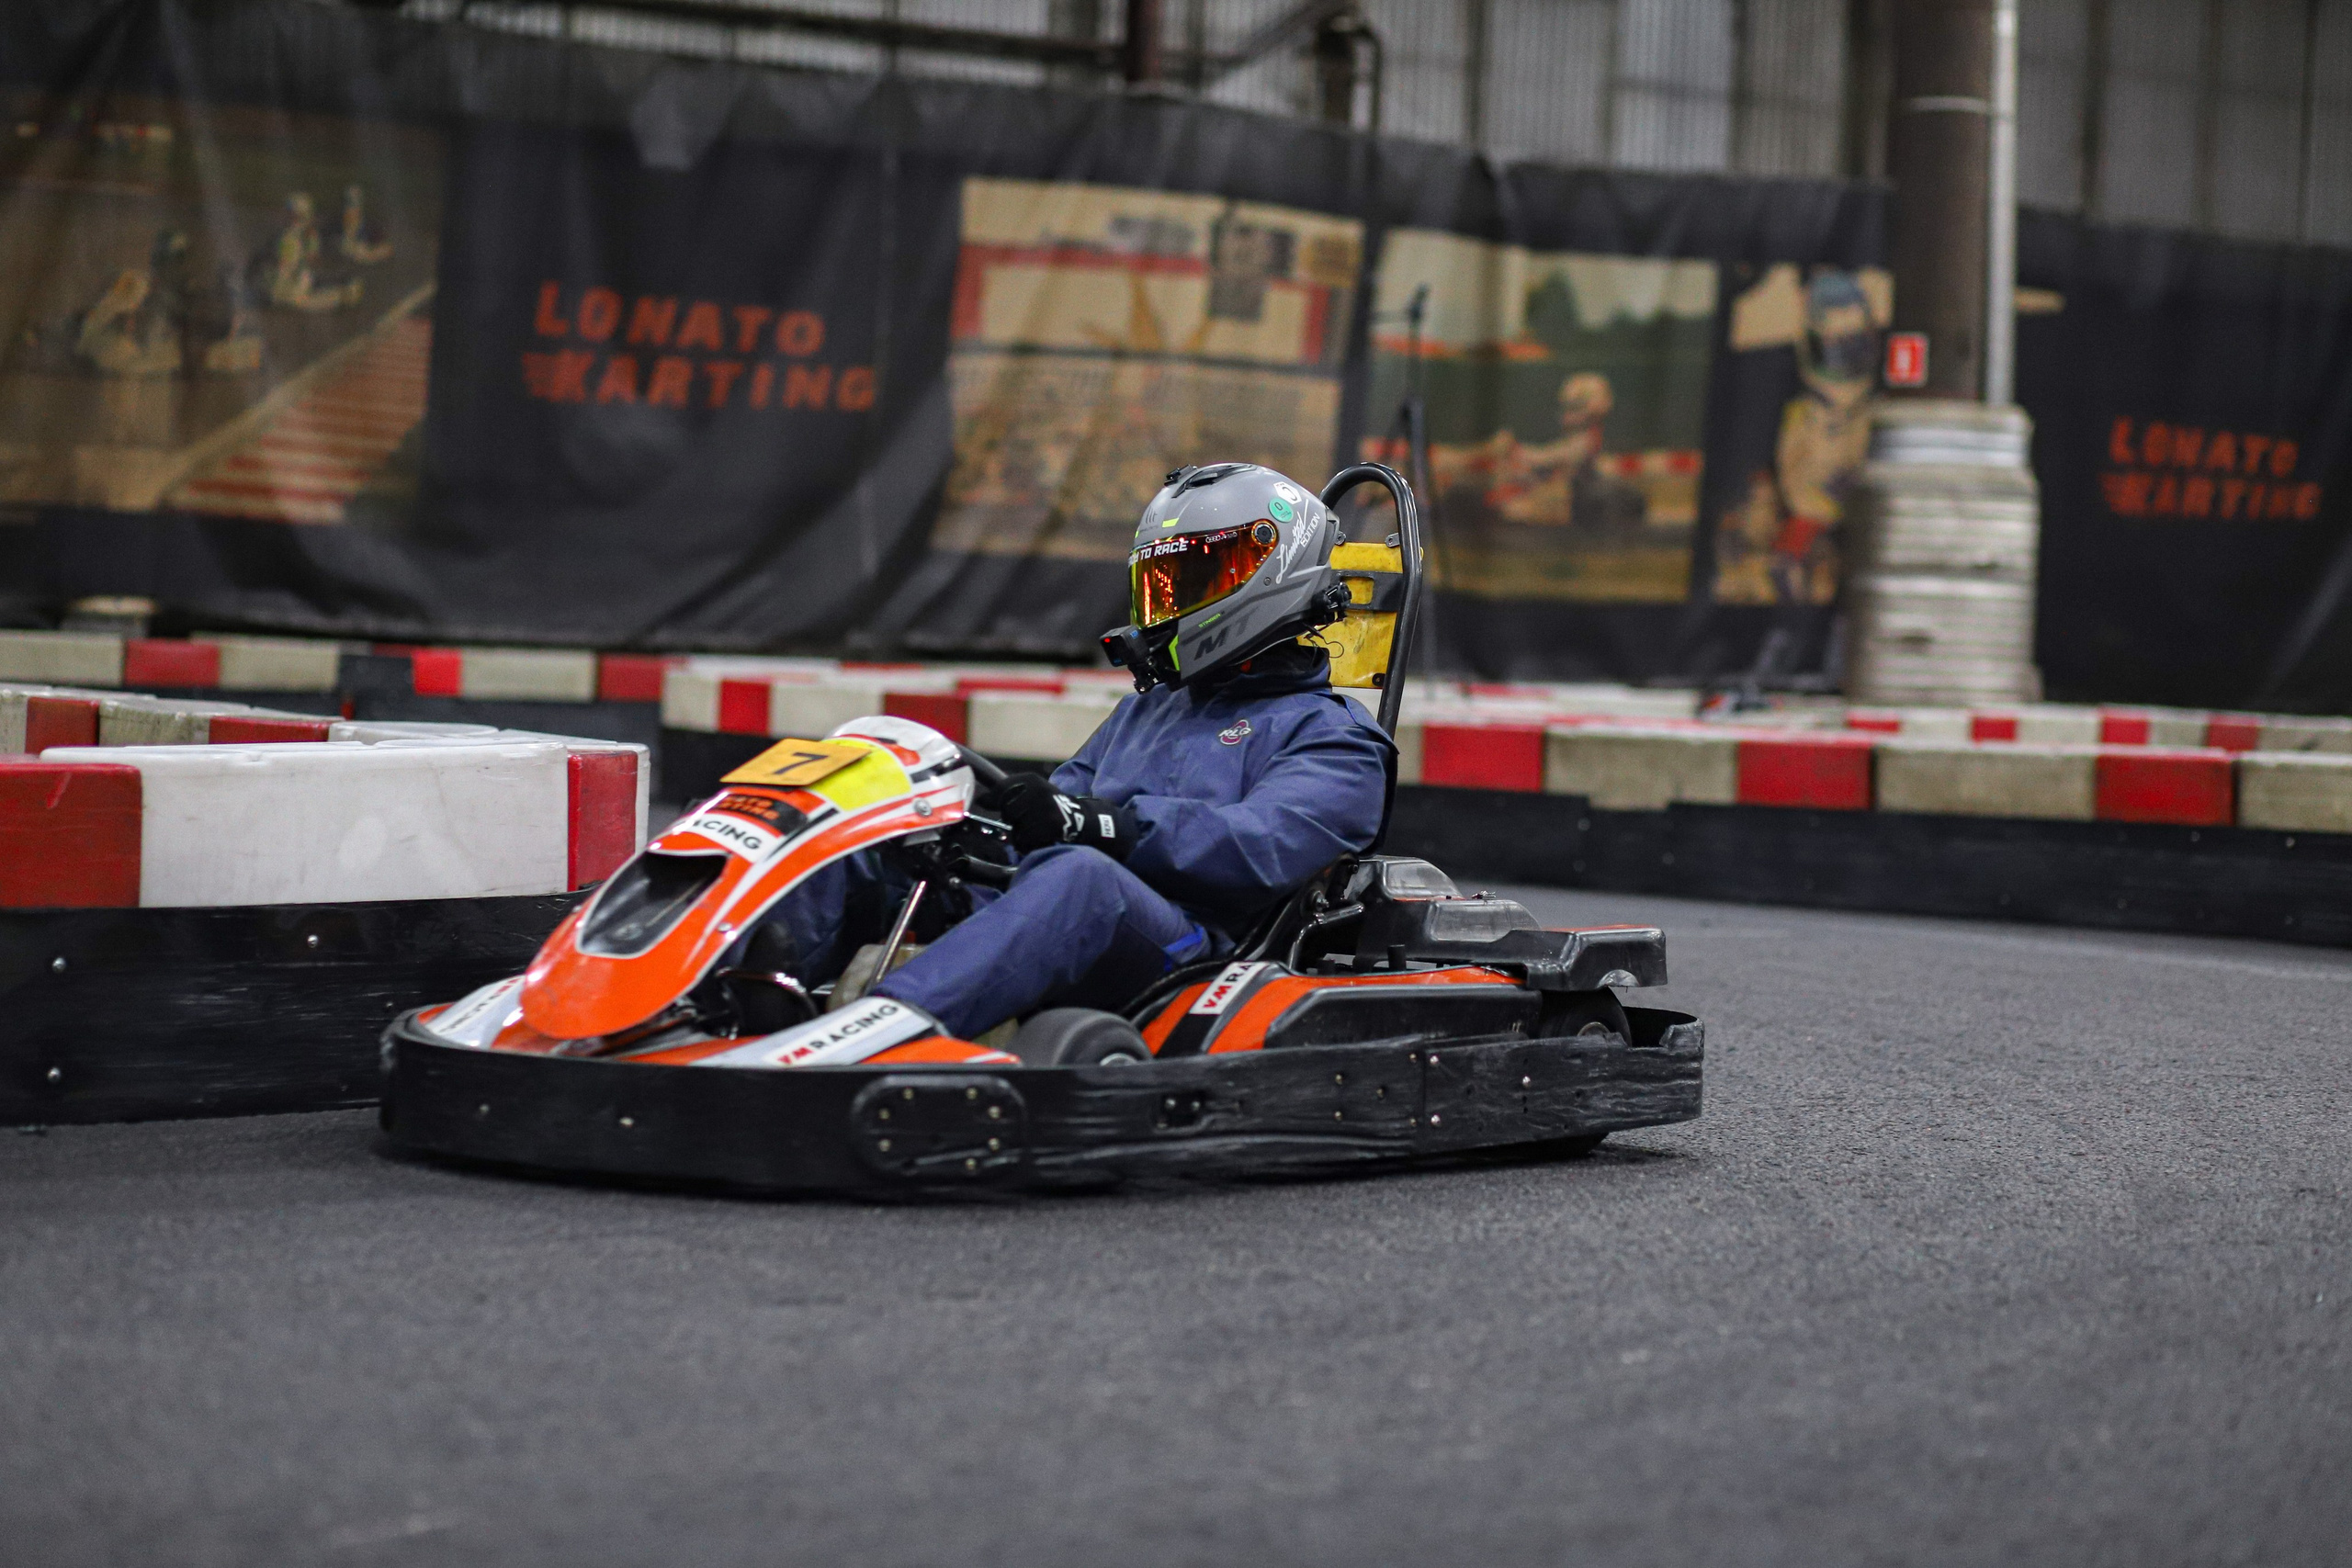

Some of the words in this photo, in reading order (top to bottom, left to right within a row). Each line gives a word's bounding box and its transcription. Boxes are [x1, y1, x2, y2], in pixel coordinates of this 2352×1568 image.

[534, 279, 825, 357] LONATO
[520, 348, 877, 412] KARTING
[2109, 415, 2299, 479] LONATO
[1140, 547, 1152, 560] TO
[1153, 539, 1189, 557] RACE
[1299, 512, 1321, 547] EDITION
[773, 751, 829, 775] 7
